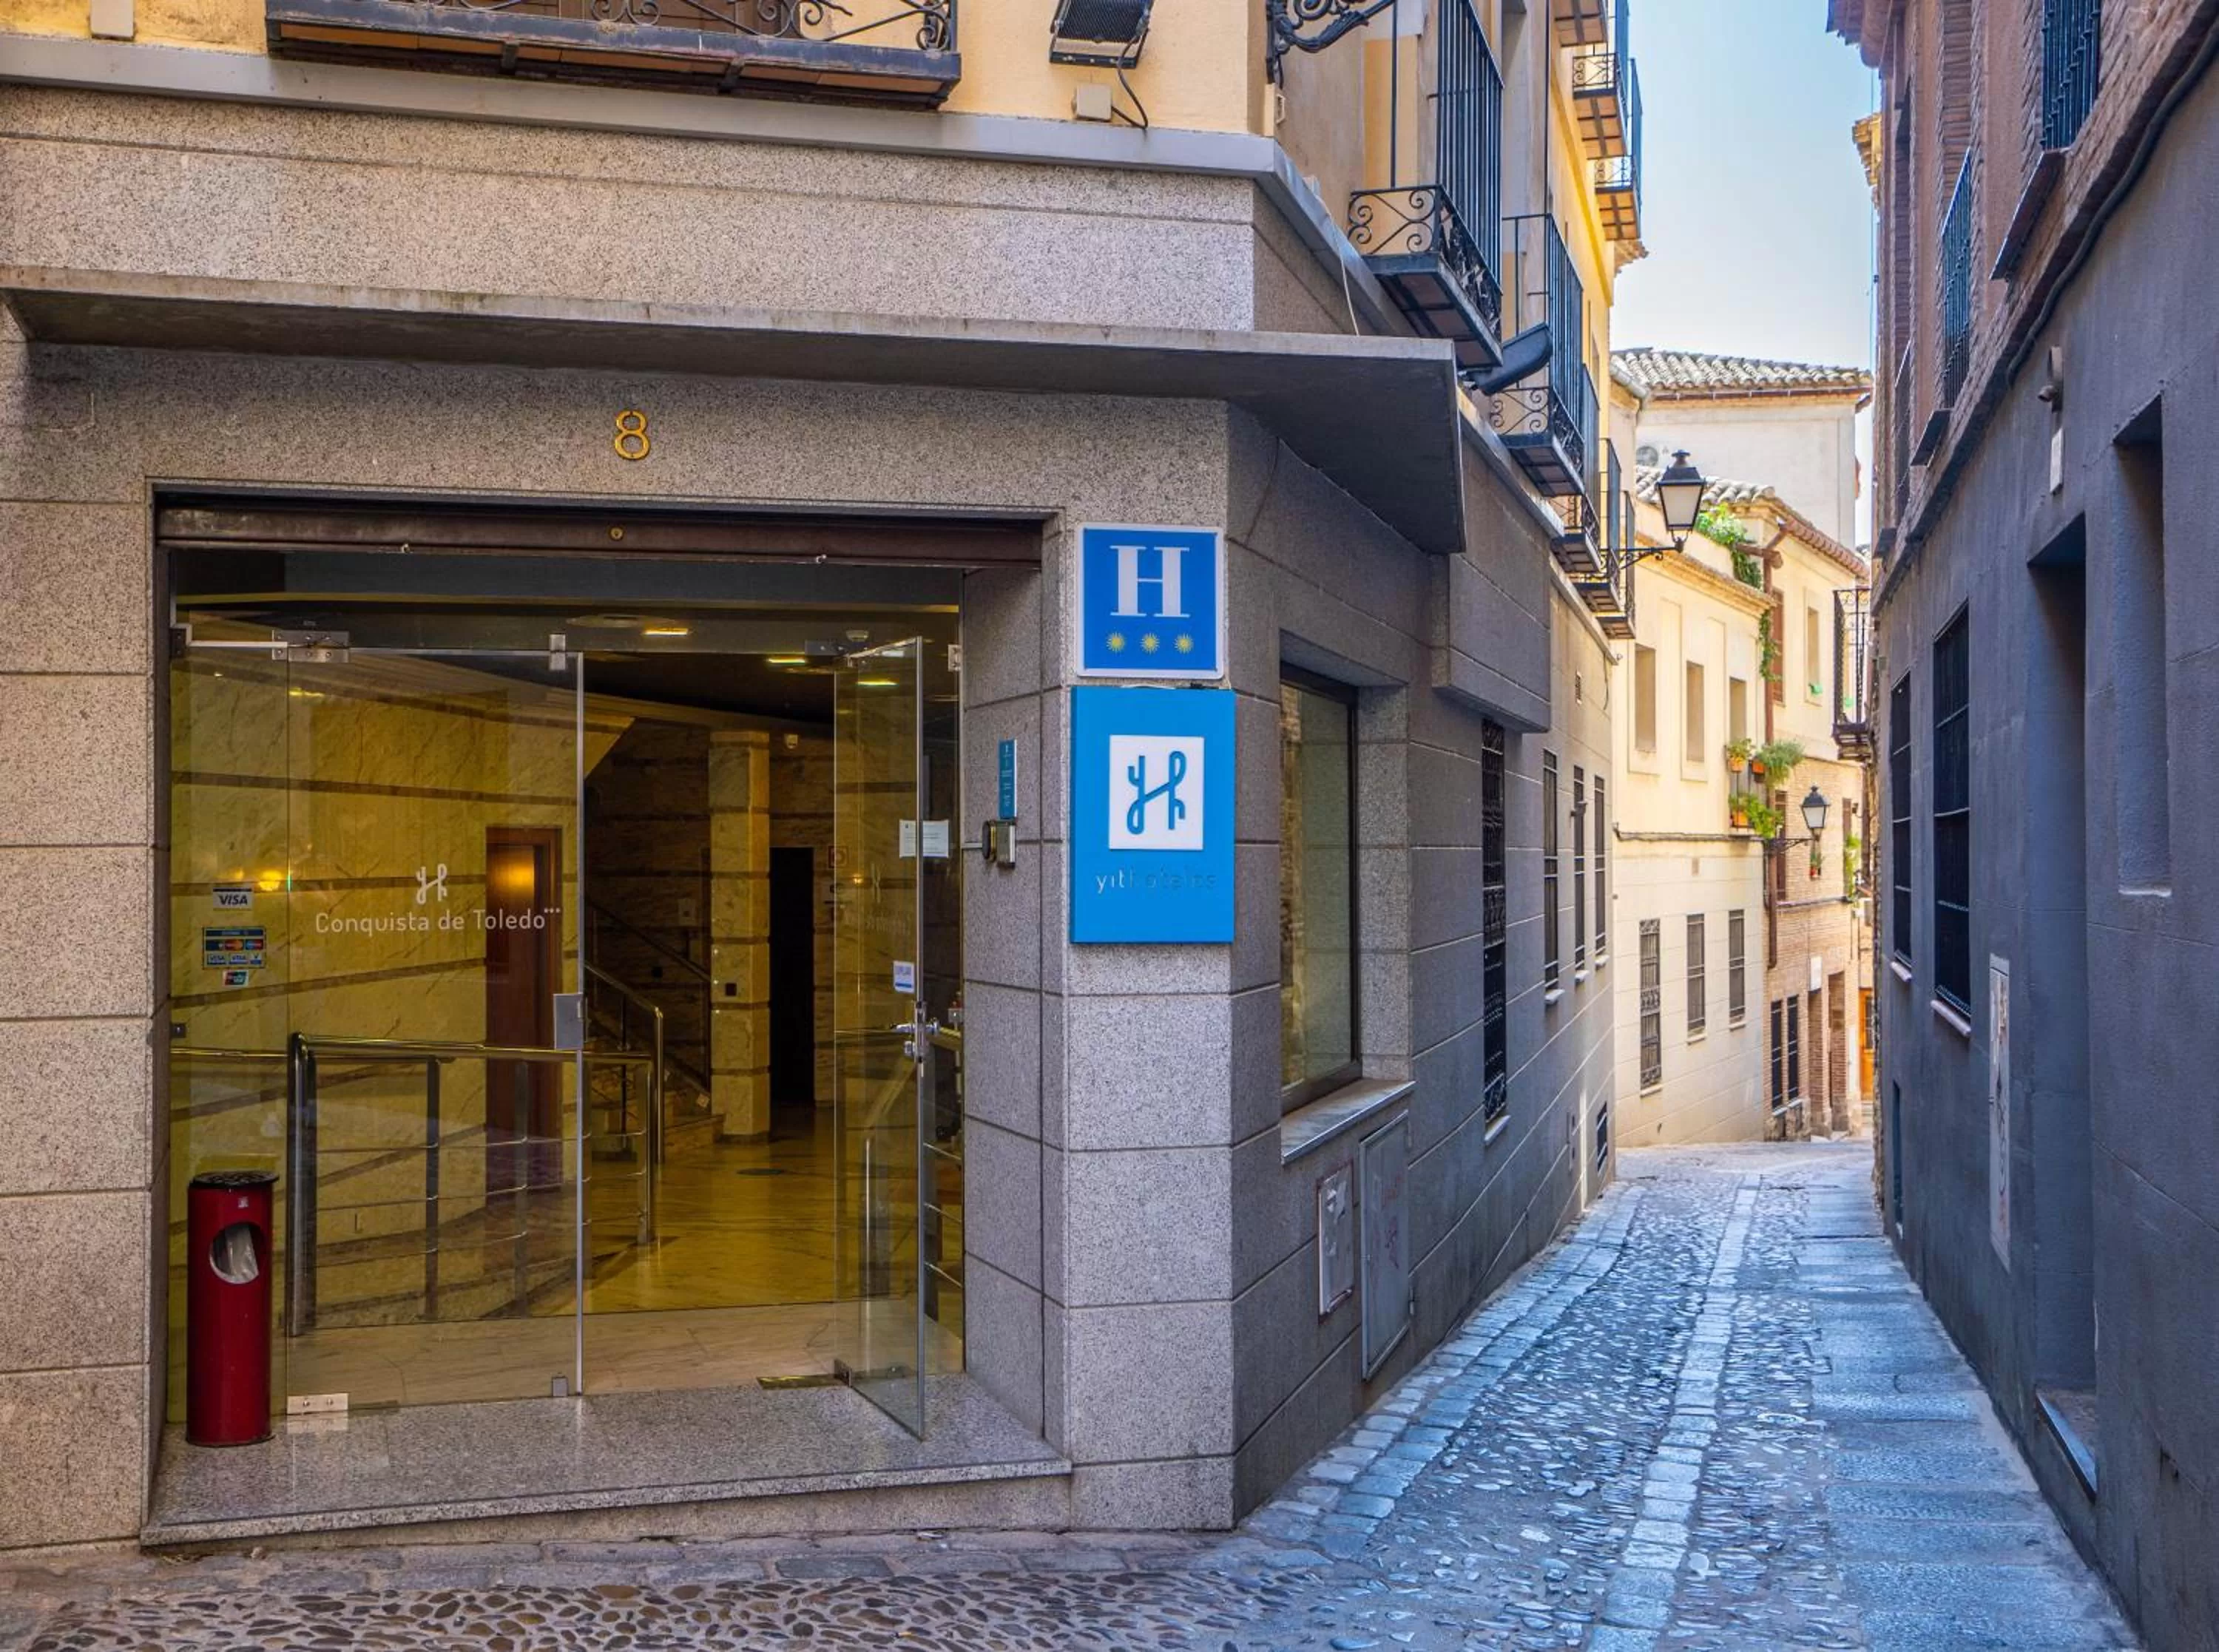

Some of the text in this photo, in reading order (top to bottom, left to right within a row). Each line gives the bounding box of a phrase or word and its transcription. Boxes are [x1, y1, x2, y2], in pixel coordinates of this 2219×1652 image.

[615, 410, 650, 460] 8
[1110, 546, 1190, 618] H
[218, 895, 248, 905] VISA
[316, 908, 546, 938] Conquista de Toledo
